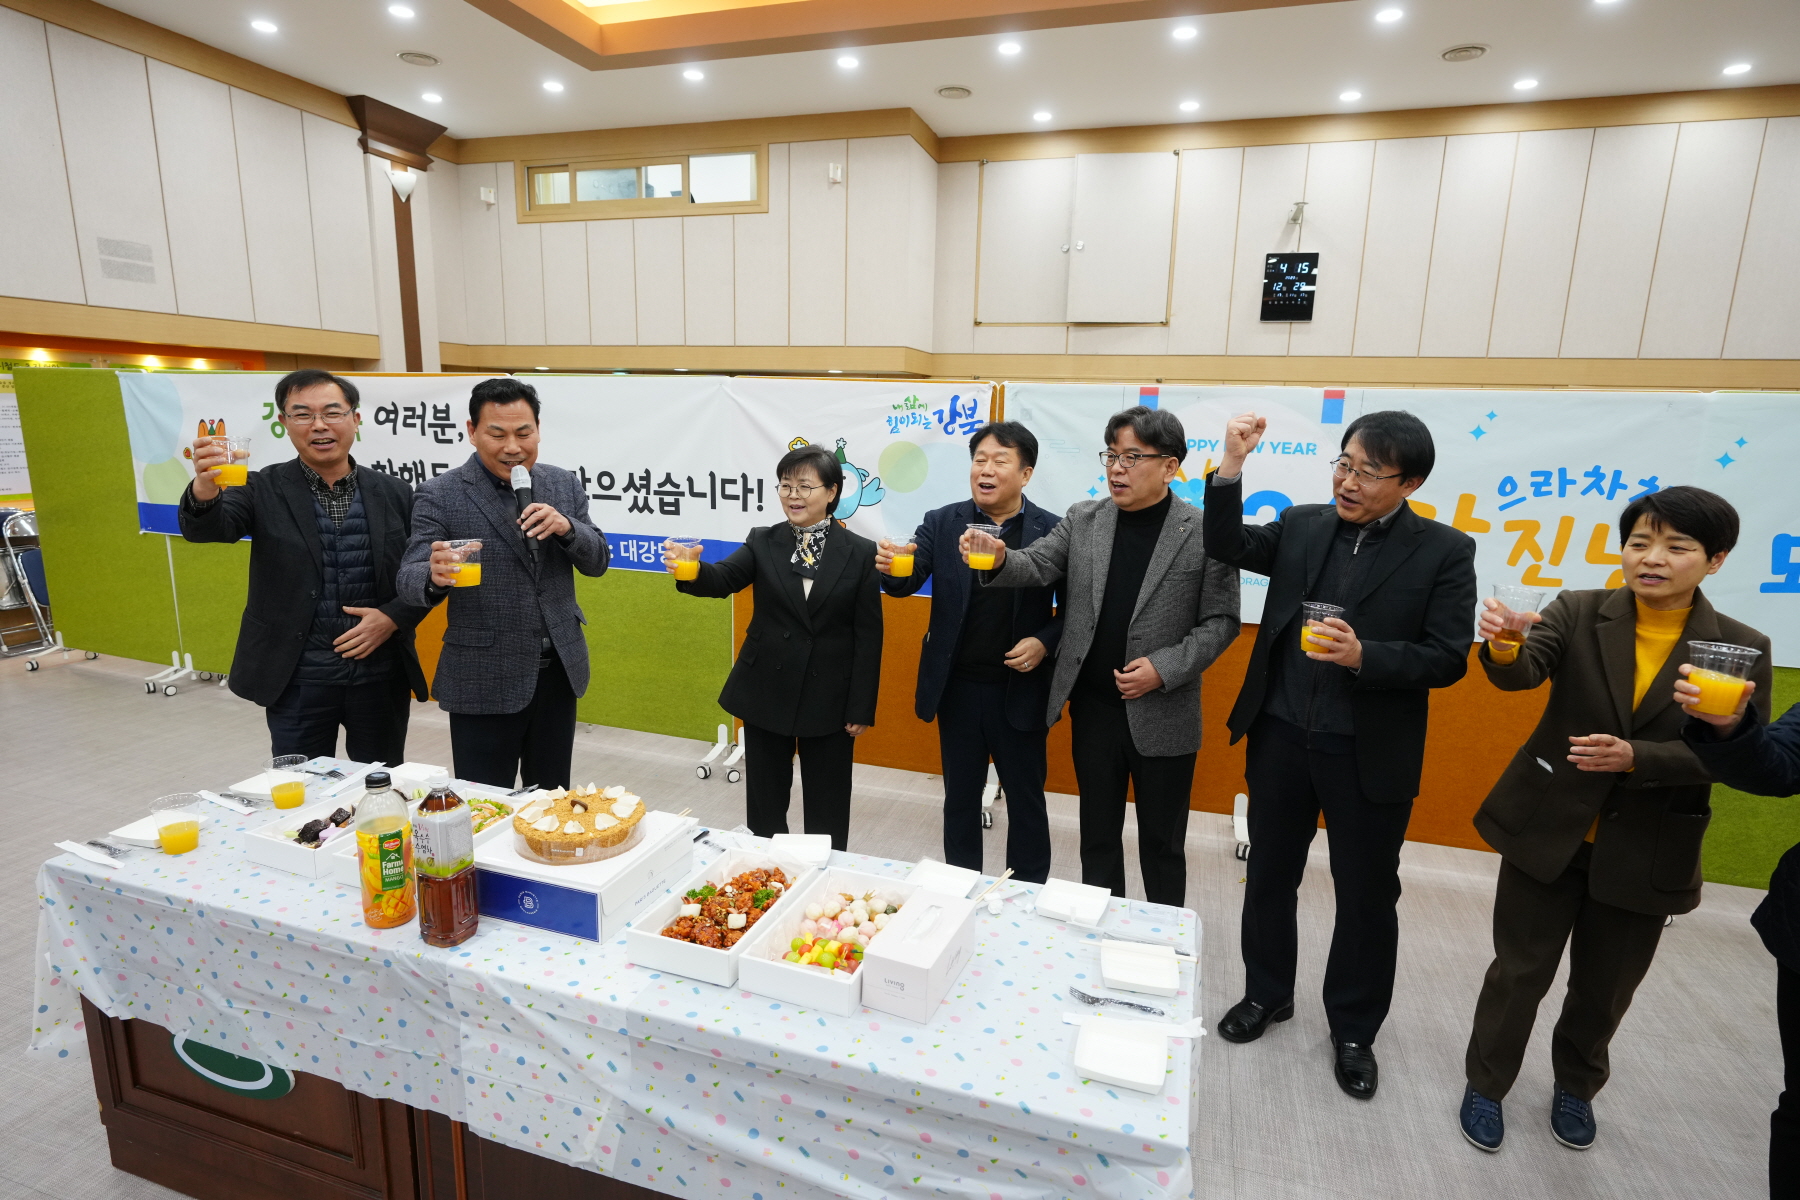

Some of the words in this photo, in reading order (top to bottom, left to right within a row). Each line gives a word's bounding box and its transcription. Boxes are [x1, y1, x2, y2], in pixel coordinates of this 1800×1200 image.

[1297, 262, 1309, 273] 15
[374, 401, 464, 444] 여러분,
[932, 394, 984, 435] 강북
[1186, 439, 1219, 452] PPY
[1269, 441, 1317, 455] YEAR
[1240, 576, 1269, 587] DRAG
